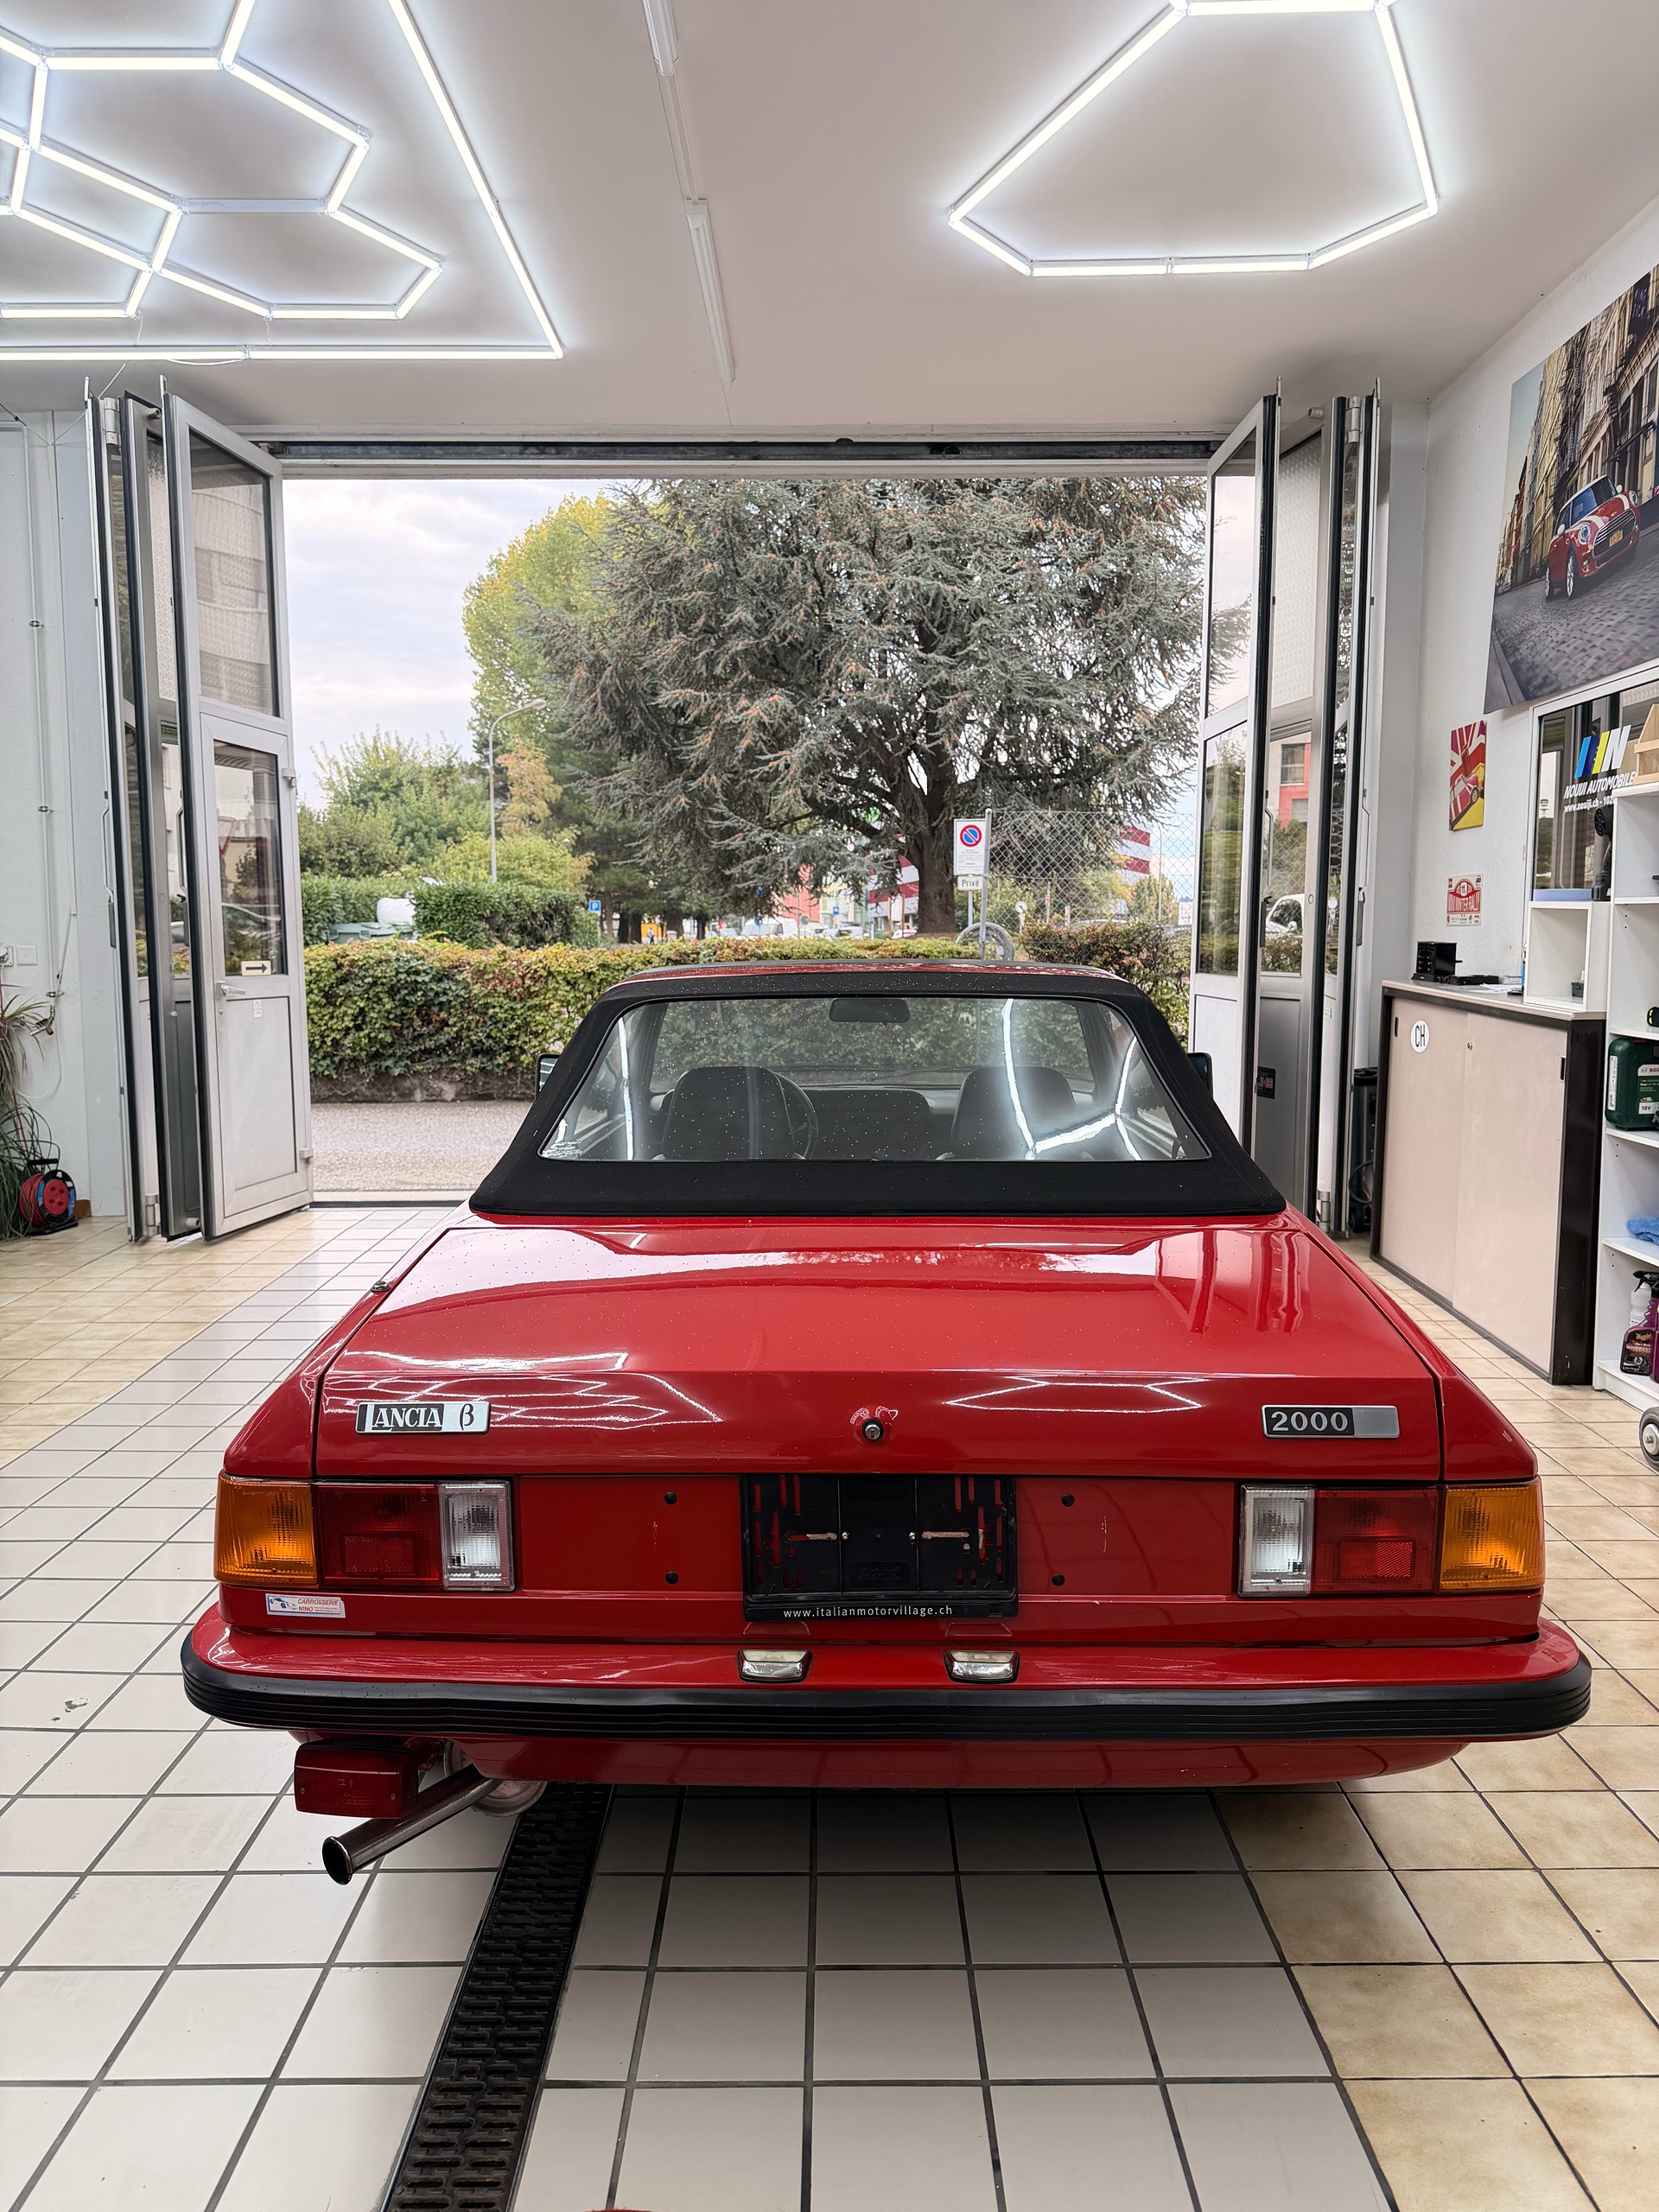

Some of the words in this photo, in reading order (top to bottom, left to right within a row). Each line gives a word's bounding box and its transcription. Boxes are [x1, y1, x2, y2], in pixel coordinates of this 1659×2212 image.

[1586, 771, 1637, 794] AUTOMOBILE
[962, 879, 979, 887] Privé
[592, 902, 598, 912] P
[1414, 1024, 1426, 1047] CH
[365, 1403, 444, 1433] LANCIA
[1271, 1411, 1348, 1431] 2000
[783, 1605, 952, 1618] www.italianmotorvillage.ch
